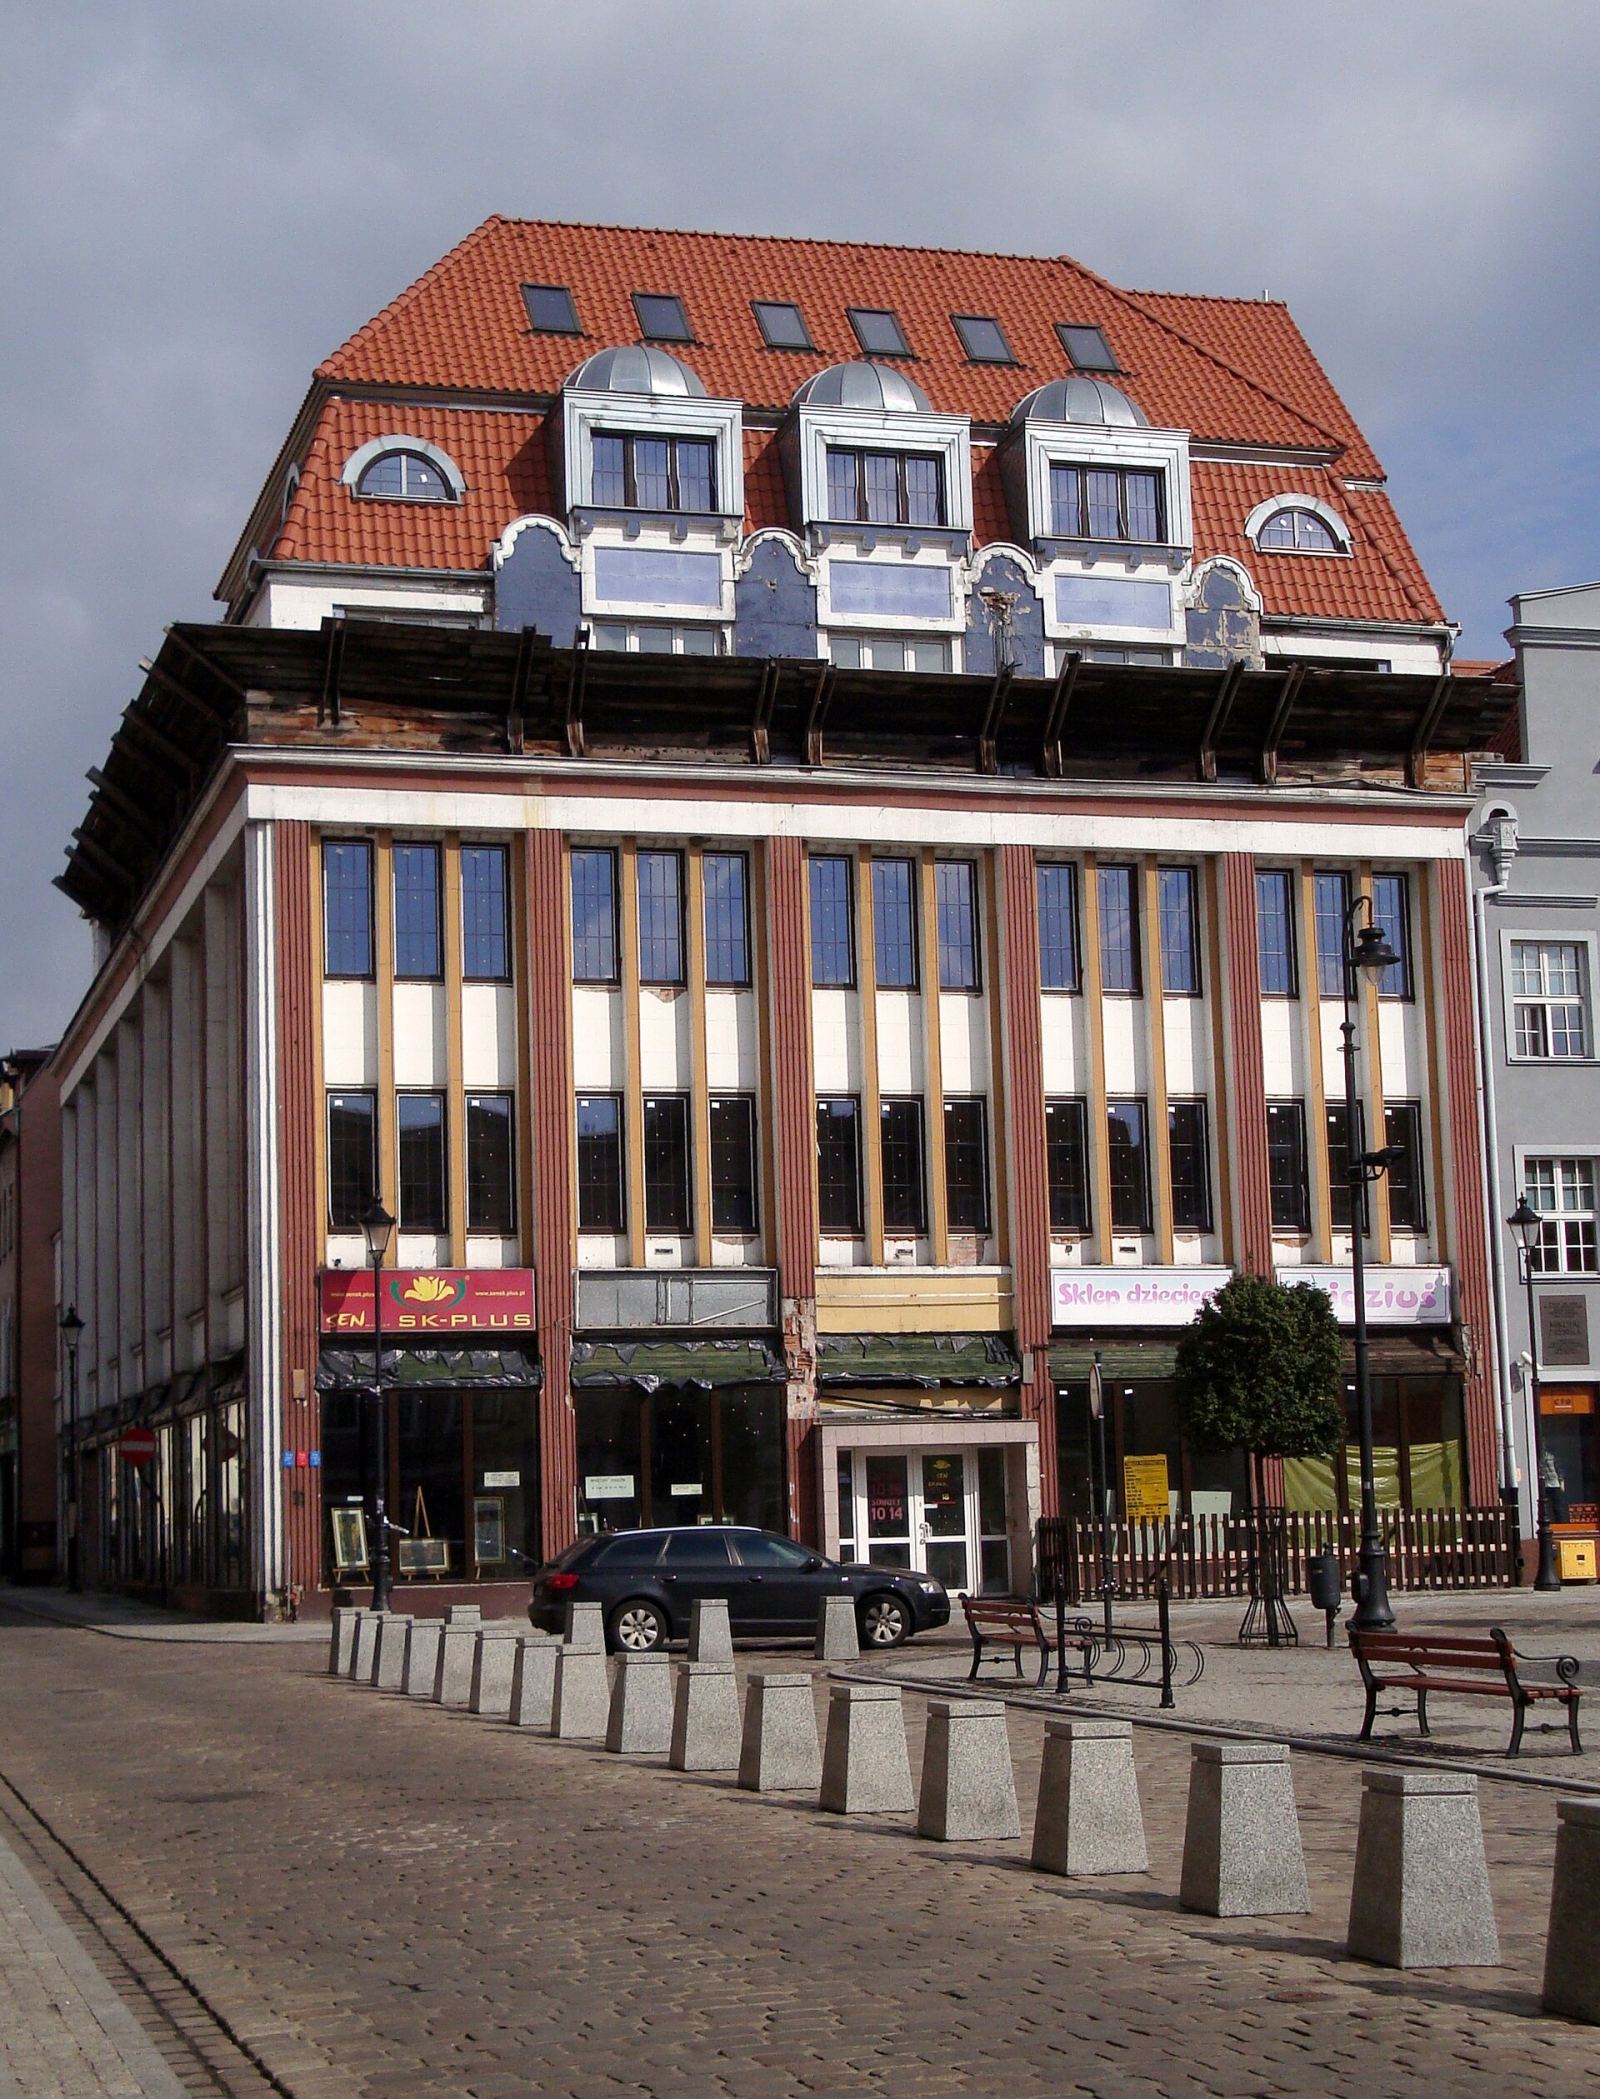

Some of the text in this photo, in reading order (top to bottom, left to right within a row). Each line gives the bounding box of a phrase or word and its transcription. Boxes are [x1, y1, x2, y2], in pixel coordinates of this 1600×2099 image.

[1059, 1283, 1121, 1308] Sklep
[326, 1311, 531, 1328] SEN SK-PLUS
[872, 1507, 903, 1520] 10 14
